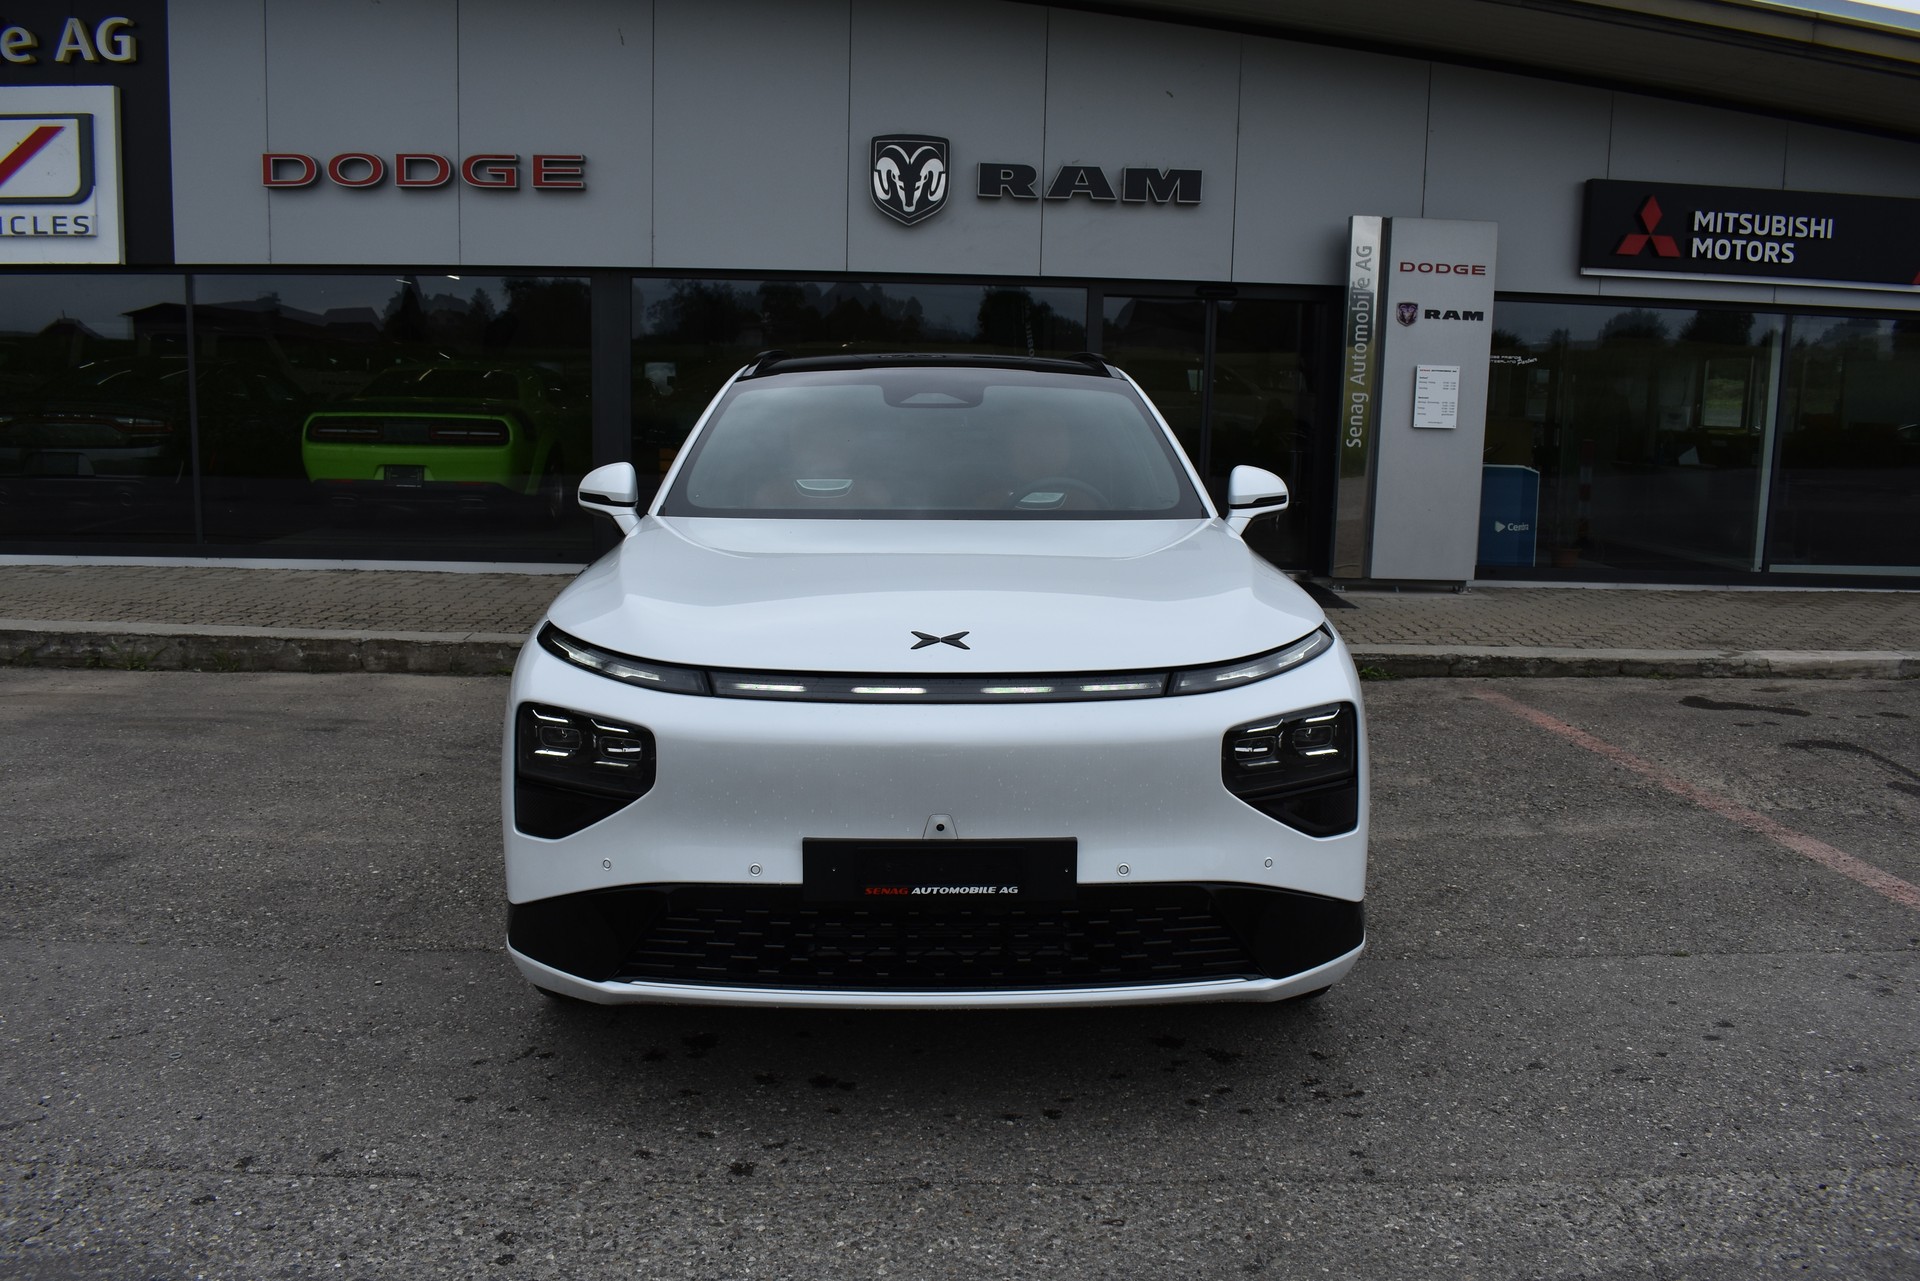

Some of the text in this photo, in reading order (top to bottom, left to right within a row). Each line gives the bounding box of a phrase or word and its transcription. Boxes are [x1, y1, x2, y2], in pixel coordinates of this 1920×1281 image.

[55, 17, 136, 63] AG
[262, 153, 586, 189] DODGE
[977, 162, 1203, 204] RAM
[1693, 210, 1834, 239] MITSUBISHI
[1691, 237, 1795, 264] MOTORS
[1400, 262, 1486, 275] DODGE
[1424, 309, 1484, 321] RAM
[1346, 245, 1373, 448] Senag Automobile AG
[864, 886, 1019, 896] SENAG AUTOMOBILE AG
